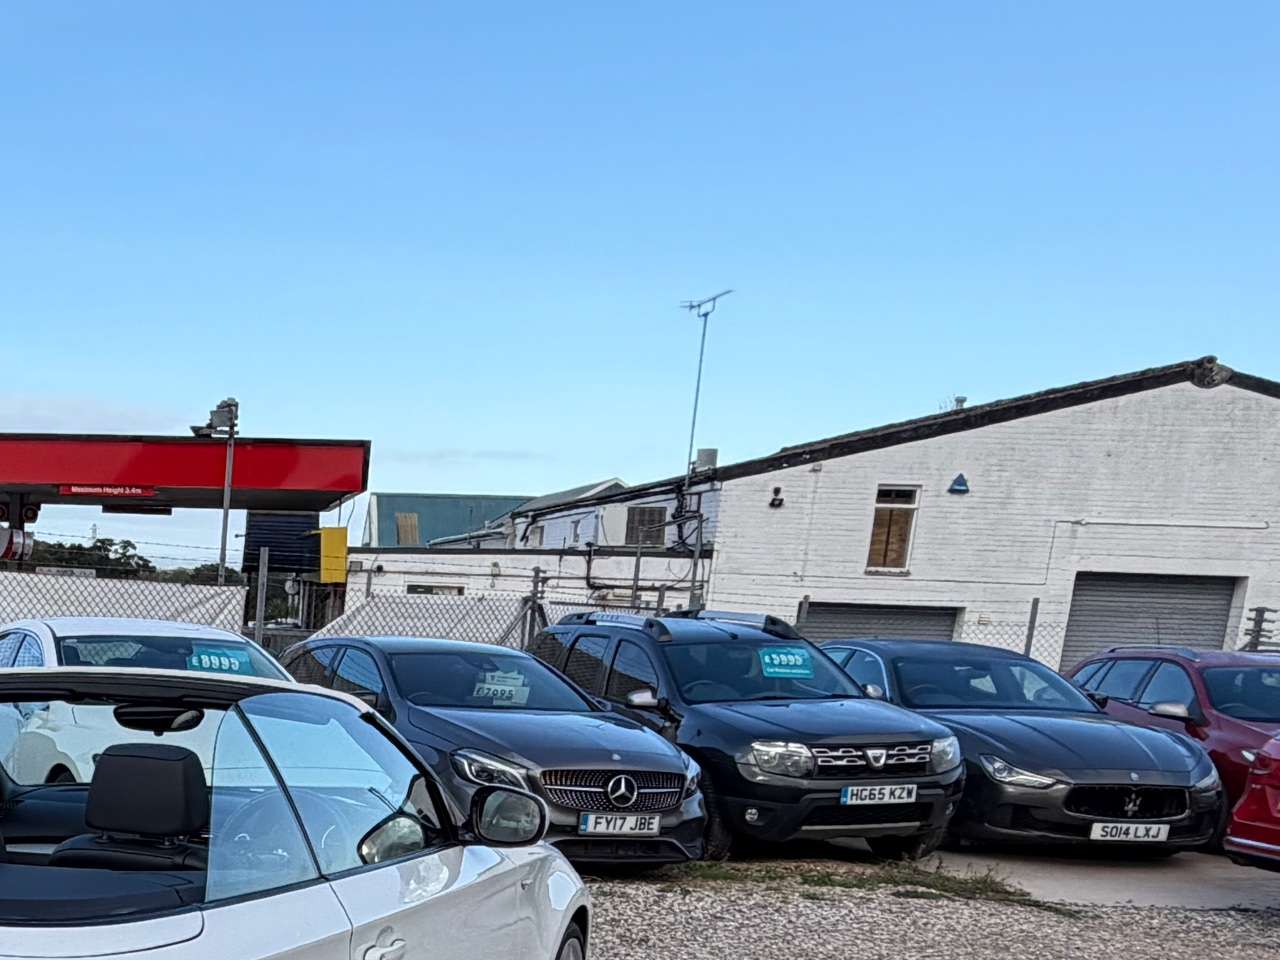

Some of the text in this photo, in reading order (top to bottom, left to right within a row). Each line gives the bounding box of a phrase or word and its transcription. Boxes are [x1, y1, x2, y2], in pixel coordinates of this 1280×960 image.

[103, 486, 124, 494] Height
[191, 654, 240, 671] £8995
[850, 786, 915, 802] HG65 KZW
[593, 816, 656, 831] FY17 JBE
[1100, 825, 1161, 839] SO14 LXJ
